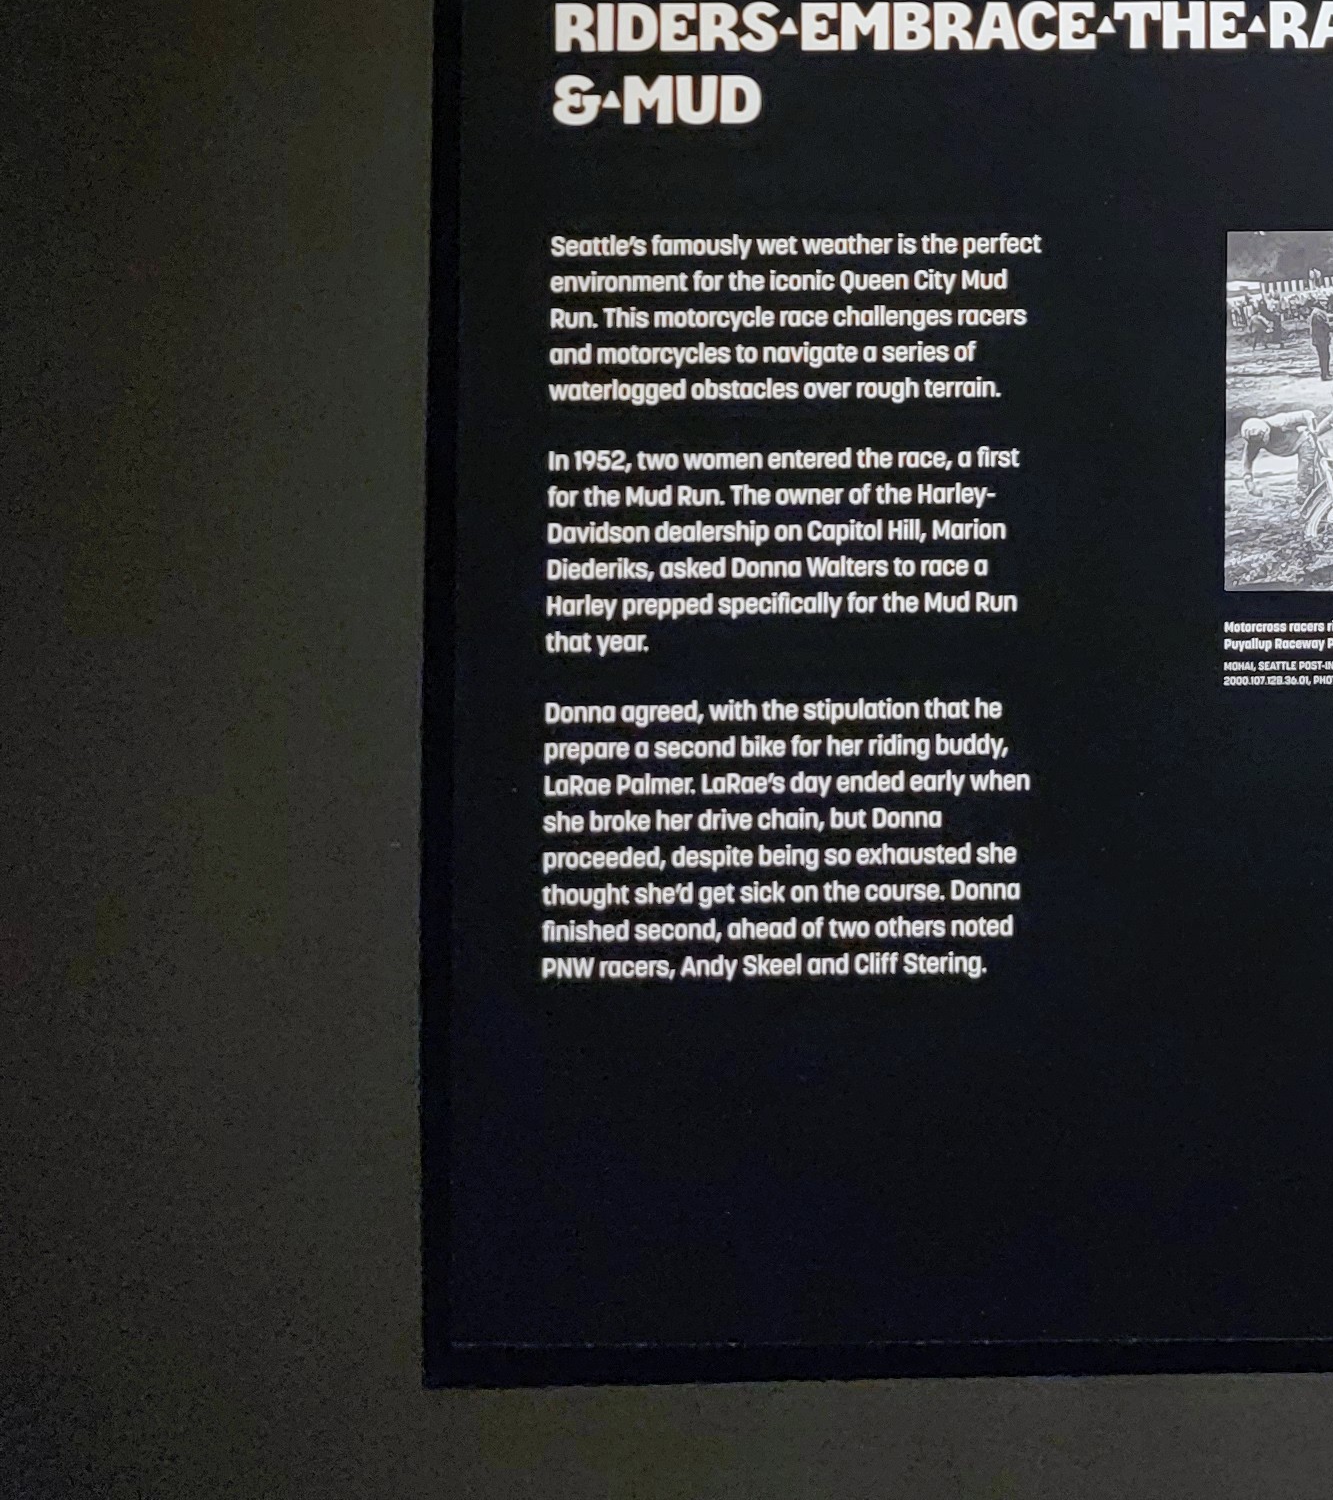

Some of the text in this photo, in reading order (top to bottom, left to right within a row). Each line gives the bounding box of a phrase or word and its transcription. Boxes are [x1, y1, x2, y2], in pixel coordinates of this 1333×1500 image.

[554, 2, 780, 53] RIDERS
[799, 0, 1097, 52] EMBRACE
[1115, 0, 1249, 51] THE
[553, 75, 763, 127] & MUD
[650, 233, 752, 260] famously
[755, 235, 798, 255] wet
[800, 232, 894, 255] weather
[897, 232, 918, 255] is
[920, 232, 959, 254] the
[962, 231, 1042, 259] perfect
[549, 267, 1008, 295] environment for the iconic Queen City Mud
[549, 304, 1028, 332] Run. This motorcycle race challenges racers
[548, 339, 977, 369] and motorcycles to navigate a series of
[547, 375, 1002, 406] waterlogged obstacles over rough terrain.
[547, 444, 1020, 474] In 1952, two women entered the race, a first
[546, 484, 579, 508] for
[582, 484, 621, 507] the
[624, 483, 673, 507] Mud
[676, 484, 726, 507] Run.
[728, 483, 771, 506] The
[774, 487, 845, 506] owner
[847, 482, 872, 505] of
[874, 482, 913, 505] the
[546, 517, 1007, 547] Davidson dealership on Capitol Hill, Marion
[546, 554, 988, 582] Diederiks, asked Donna Walters to race a
[545, 589, 1018, 621] Harley prepped specifically for the Mud Run
[1223, 620, 1287, 633] Motorcross
[1288, 621, 1325, 633] racers
[544, 630, 649, 657] that year.
[1223, 636, 1273, 652] Puyallup
[1273, 637, 1326, 652] Raceway
[1223, 660, 1257, 672] MOHAI,
[1257, 660, 1297, 671] SEATTLE
[544, 696, 1003, 728] Donna agreed, with the stipulation that he
[542, 841, 1017, 874] proceeded, despite being so exhausted she
[541, 950, 987, 981] PNW racers, Andy Skeel and Cliff Stering.
